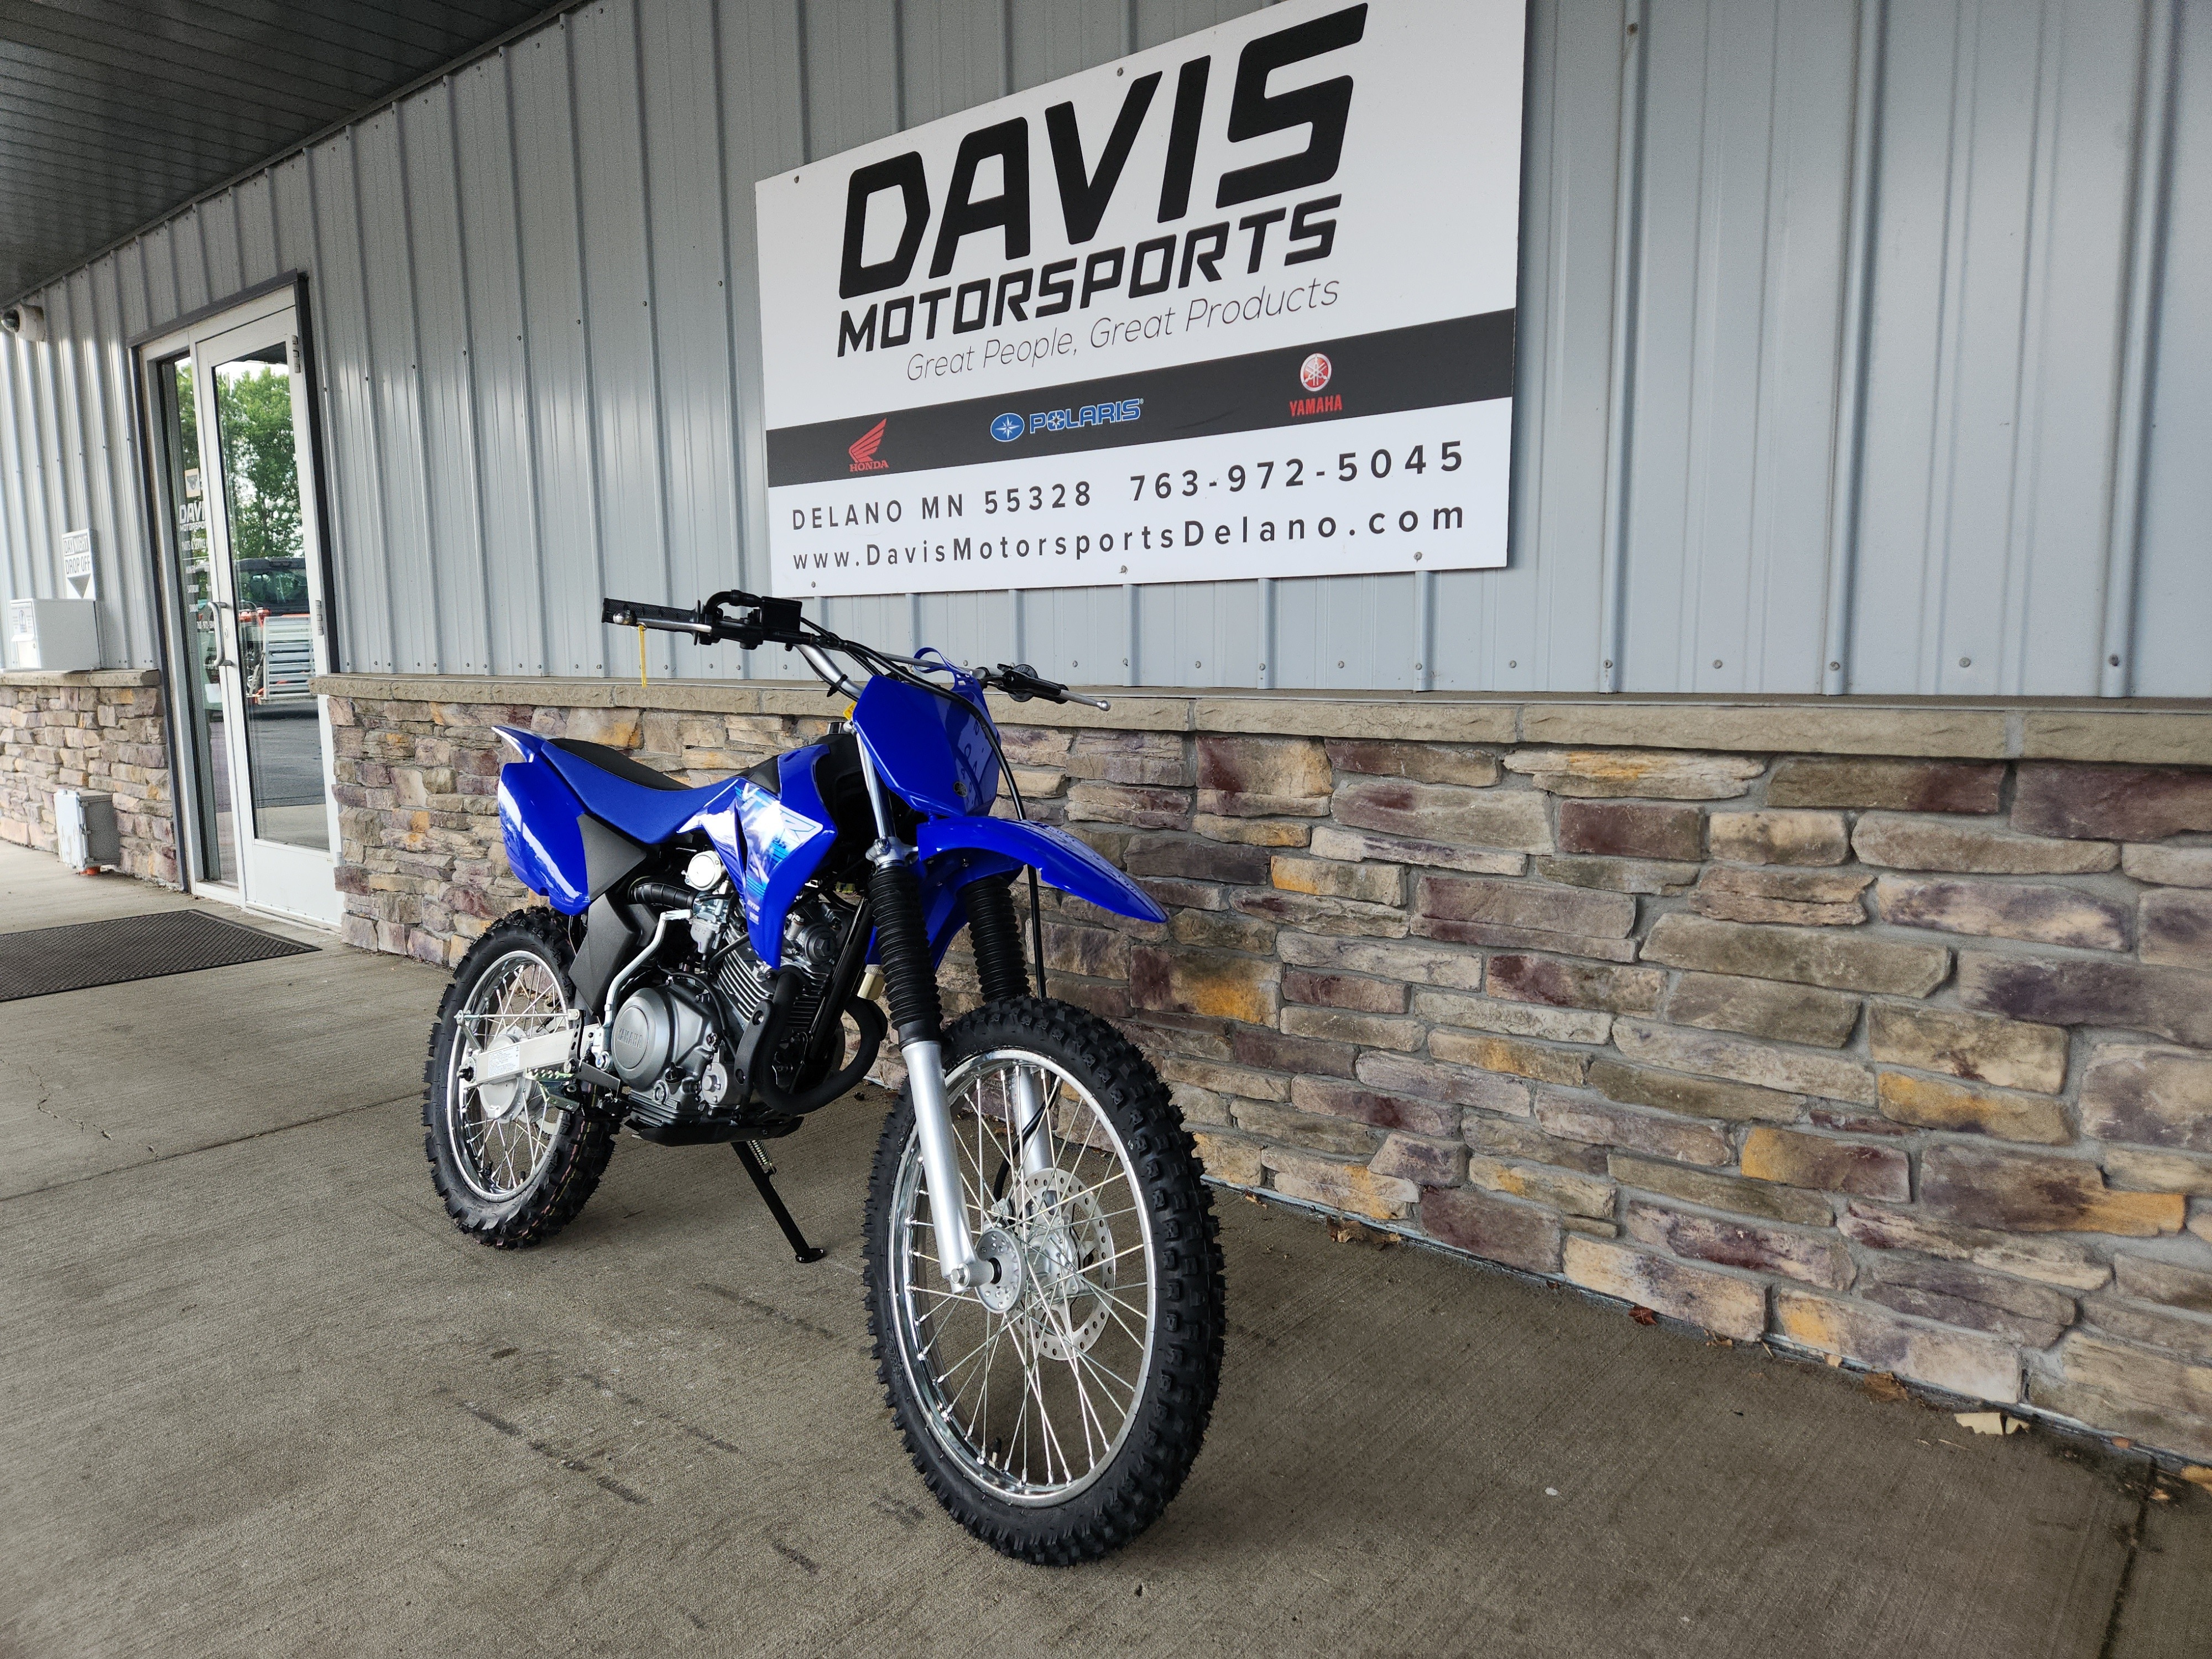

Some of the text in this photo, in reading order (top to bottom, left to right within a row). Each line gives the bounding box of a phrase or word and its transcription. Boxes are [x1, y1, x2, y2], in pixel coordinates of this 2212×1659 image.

[839, 3, 1368, 299] DAVIS
[838, 194, 1342, 357] MOTORSPORTS
[907, 278, 1339, 380] Great People, Great Products
[1029, 398, 1141, 434] POLARIS
[1290, 394, 1343, 417] YAMAHA
[849, 460, 889, 472] HONDA
[792, 440, 1462, 530] DELANO MN 55328 763-972-5045
[179, 500, 206, 524] DAVI
[180, 521, 207, 531] MOTORSPO
[64, 535, 88, 554] DAY NIGHT
[793, 507, 1463, 570] www.DavisMotorsportsDelano.com
[65, 555, 90, 574] DROP OFF
[617, 1027, 643, 1048] YAMAHA
